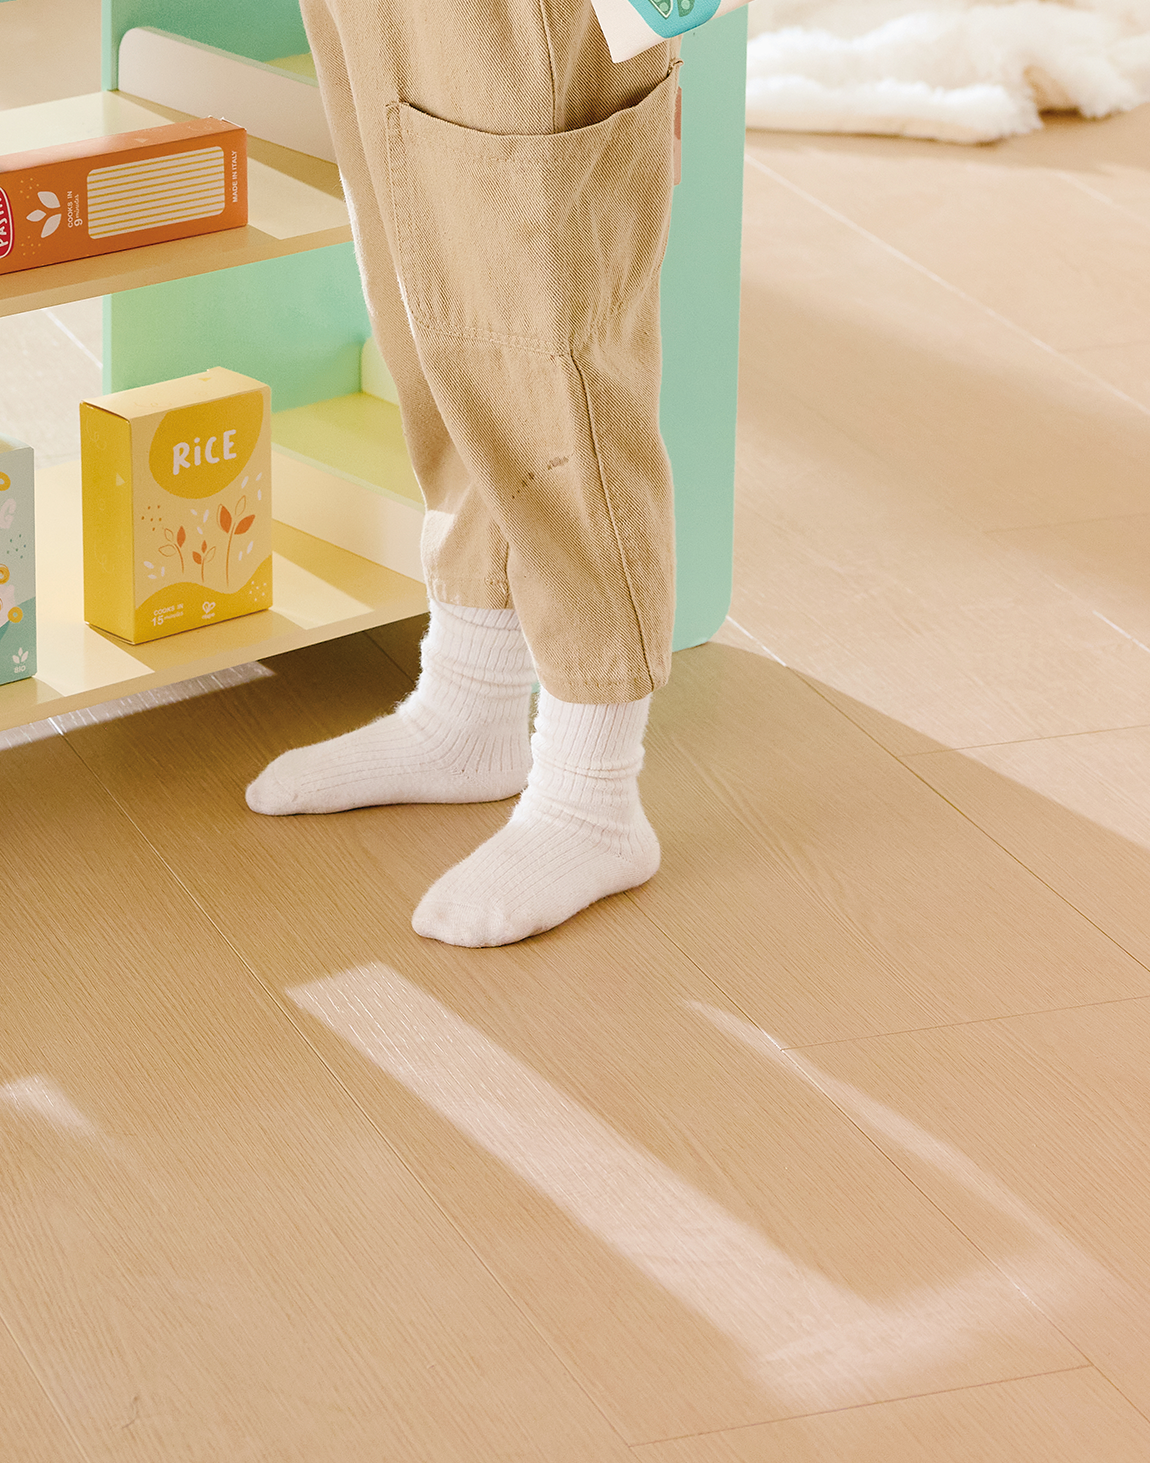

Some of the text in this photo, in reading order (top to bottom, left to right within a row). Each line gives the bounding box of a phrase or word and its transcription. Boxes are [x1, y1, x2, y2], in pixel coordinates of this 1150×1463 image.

[231, 171, 238, 180] IN
[67, 190, 73, 199] IN
[151, 615, 164, 627] 15
[13, 665, 27, 674] BIO
